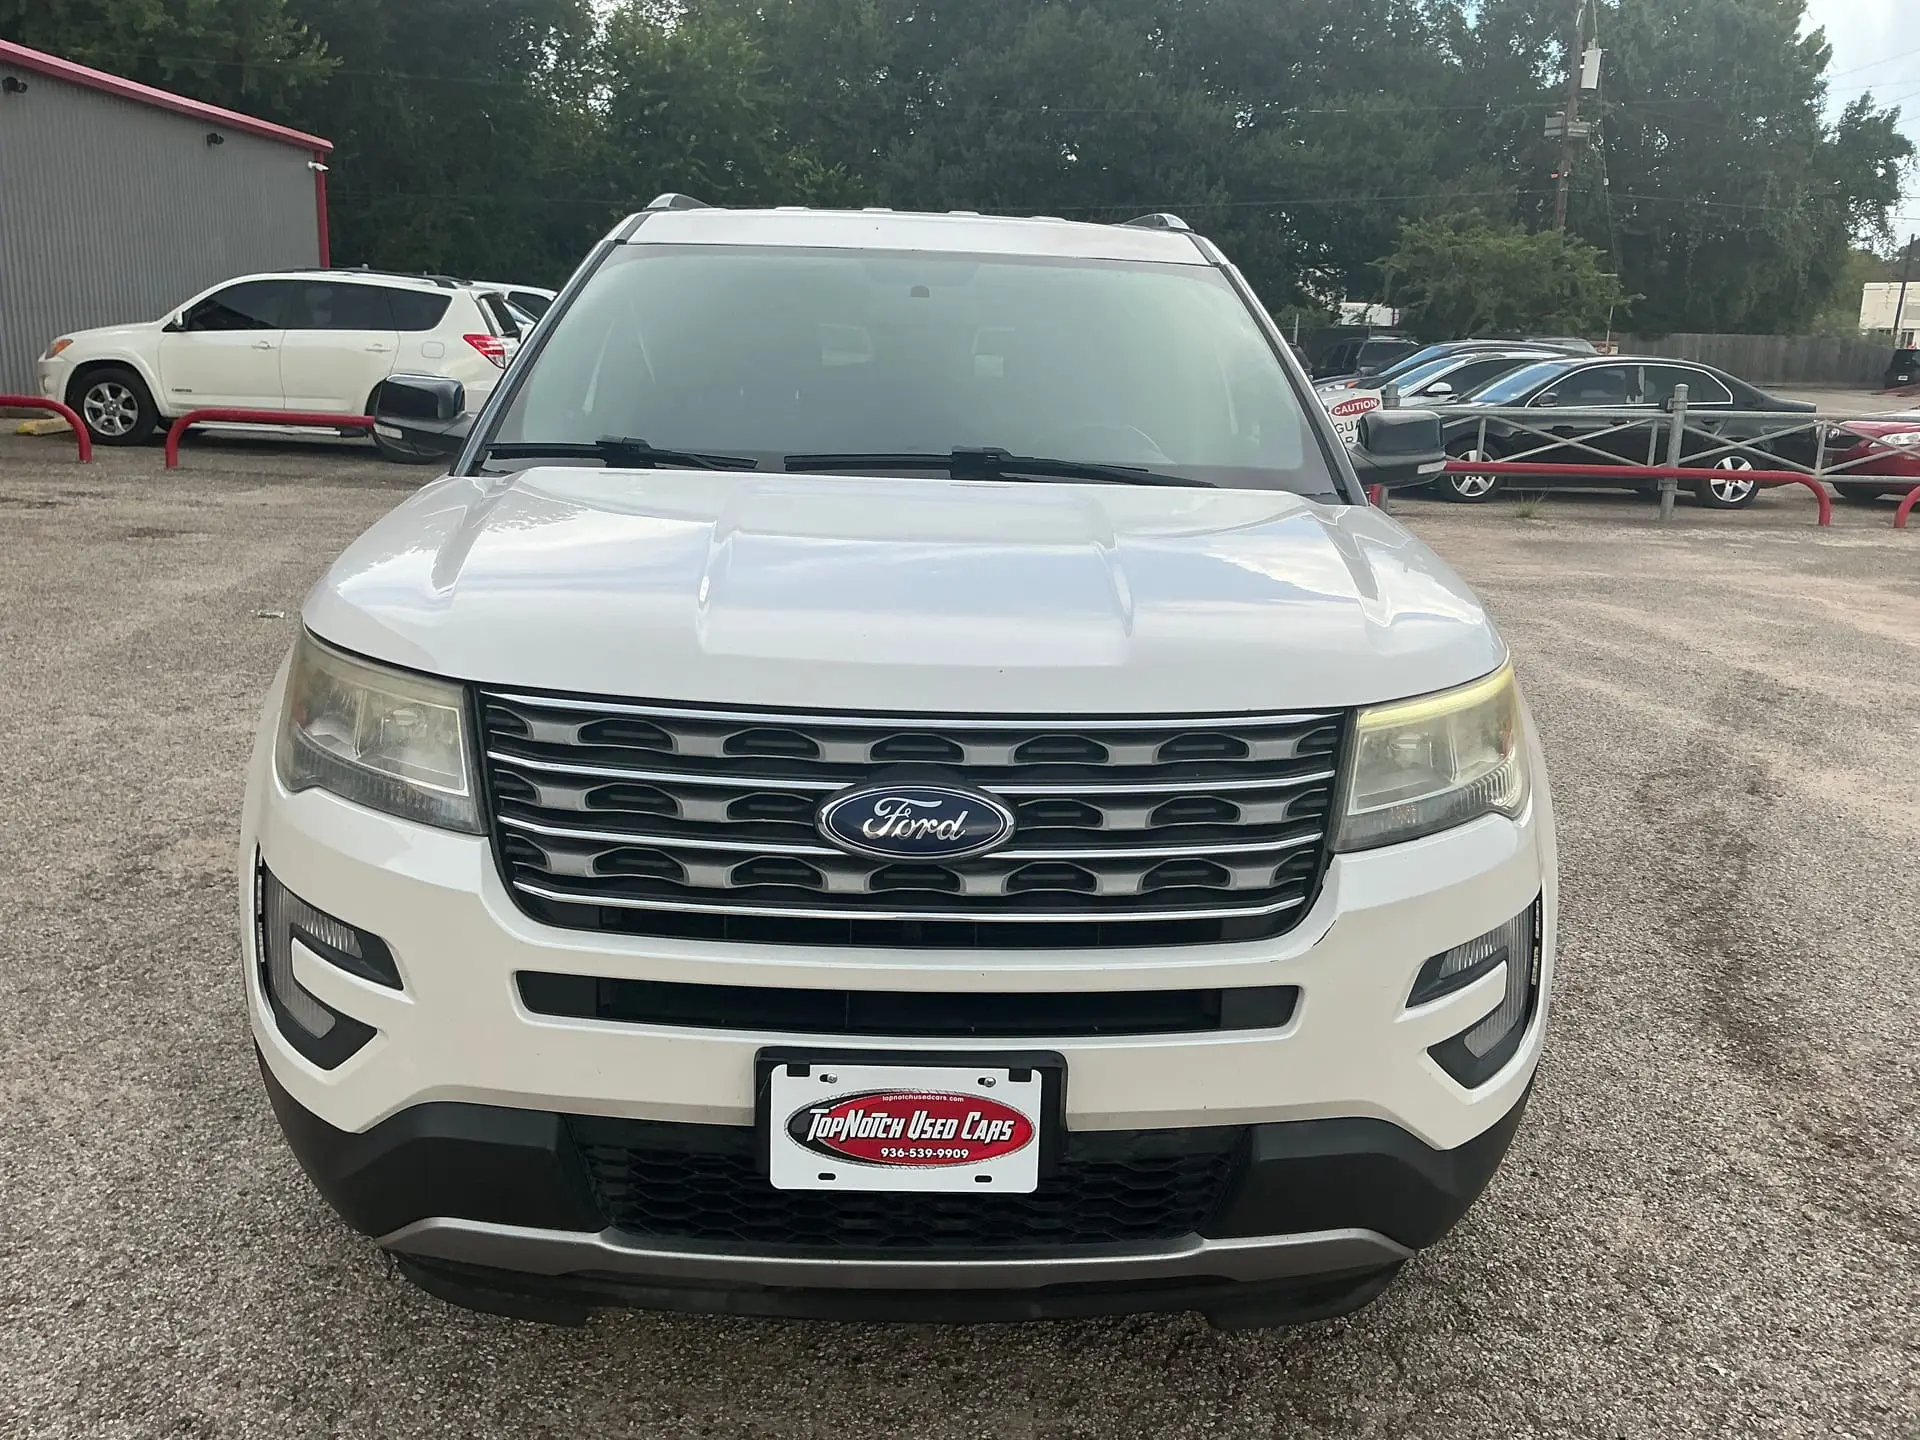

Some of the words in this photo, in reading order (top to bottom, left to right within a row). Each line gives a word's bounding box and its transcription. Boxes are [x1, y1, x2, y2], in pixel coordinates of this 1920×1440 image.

[1334, 399, 1378, 415] CAUTION
[863, 797, 968, 840] Ford
[882, 1094, 964, 1102] topnotchusedcars.com
[881, 1147, 969, 1159] 936-539-9909
